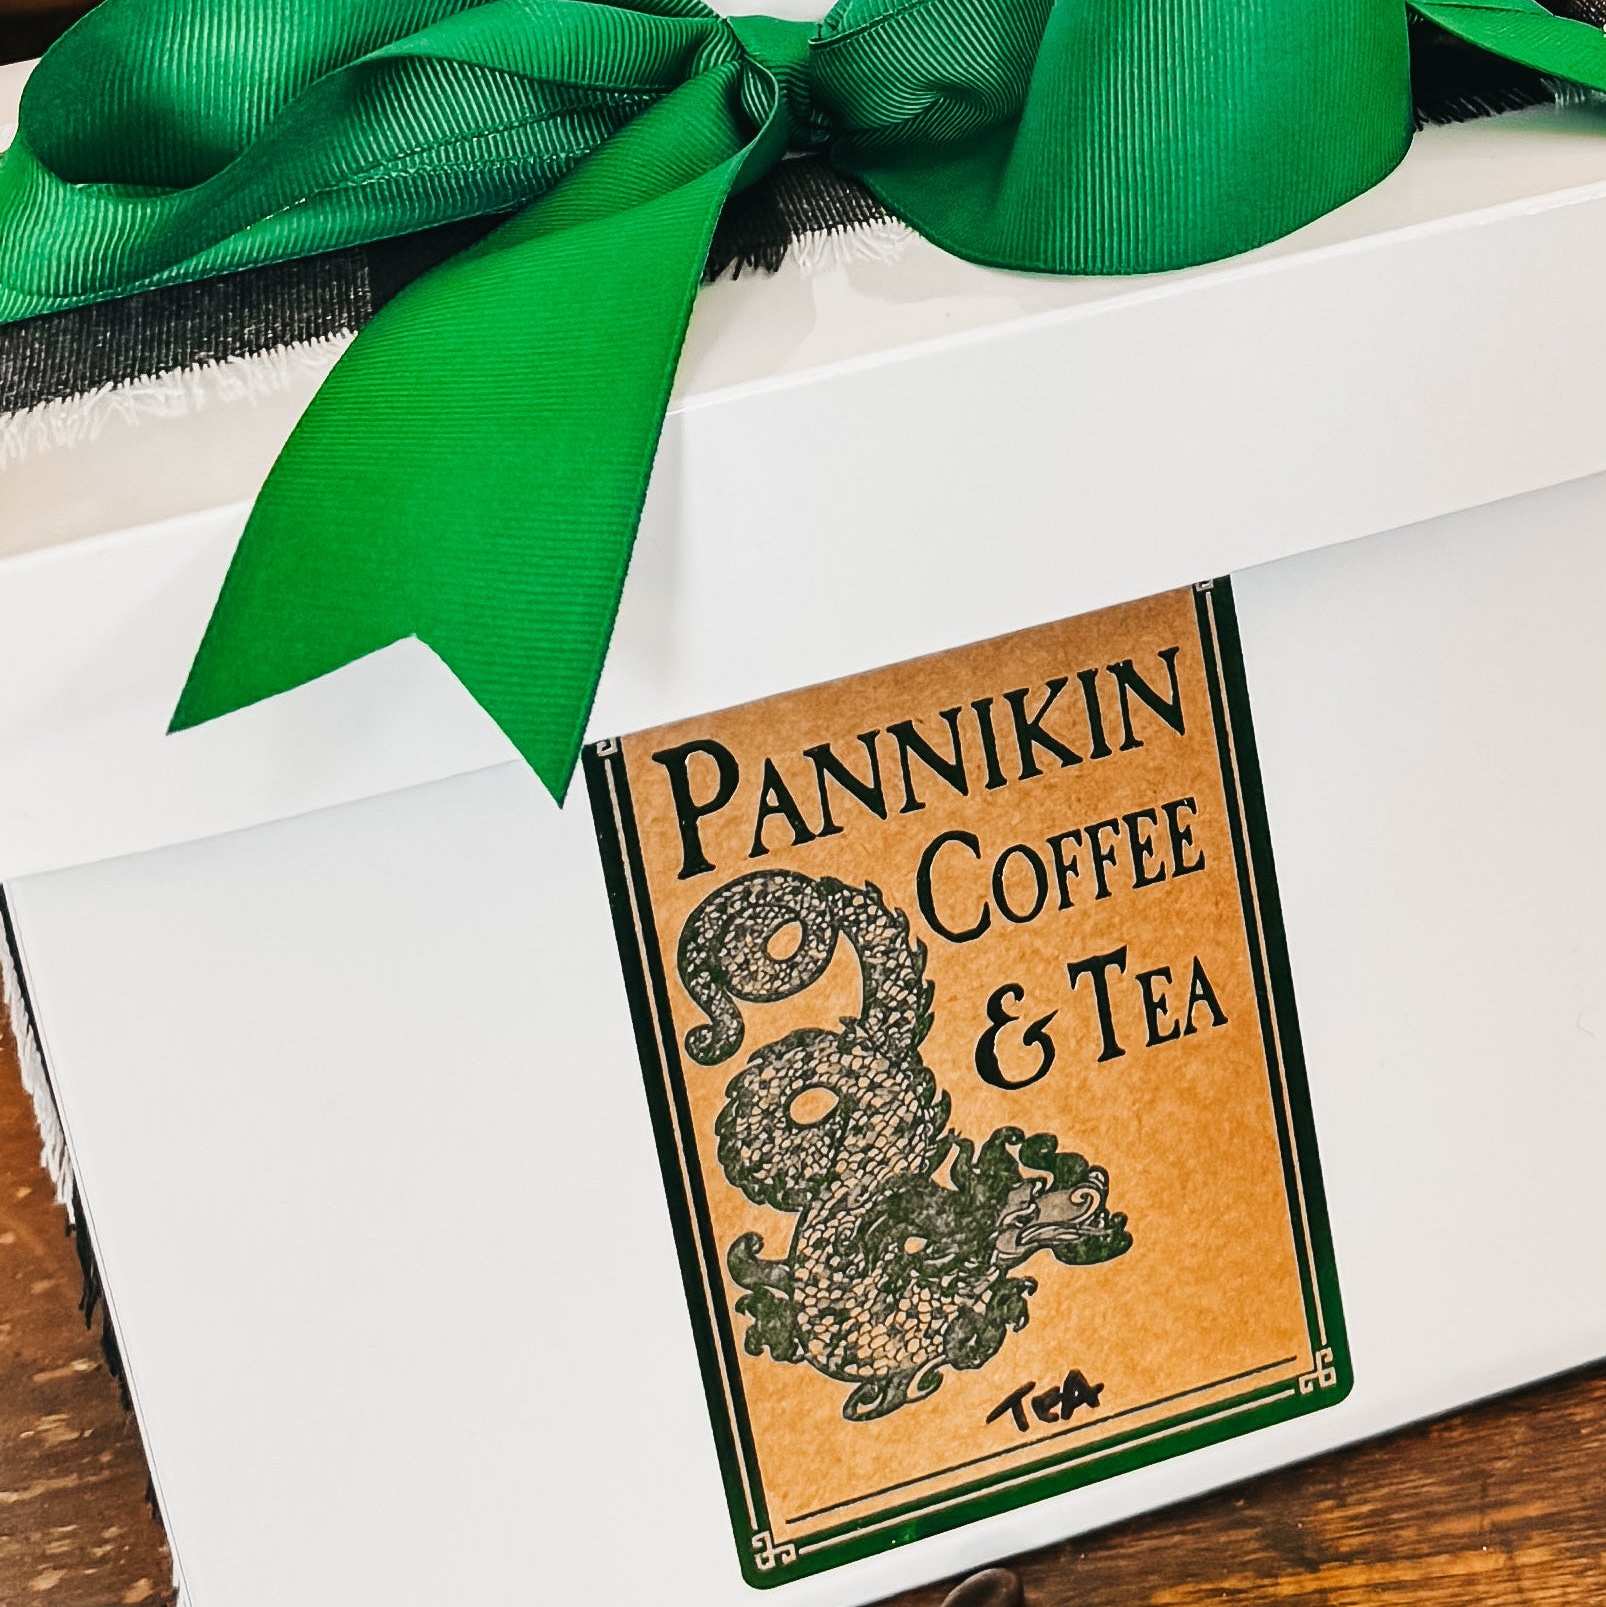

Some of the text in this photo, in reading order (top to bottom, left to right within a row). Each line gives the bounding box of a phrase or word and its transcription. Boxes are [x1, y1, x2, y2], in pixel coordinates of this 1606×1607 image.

[652, 646, 1188, 880] PANNIKIN
[915, 797, 1206, 943] COFFEE
[974, 945, 1229, 1091] & TEA
